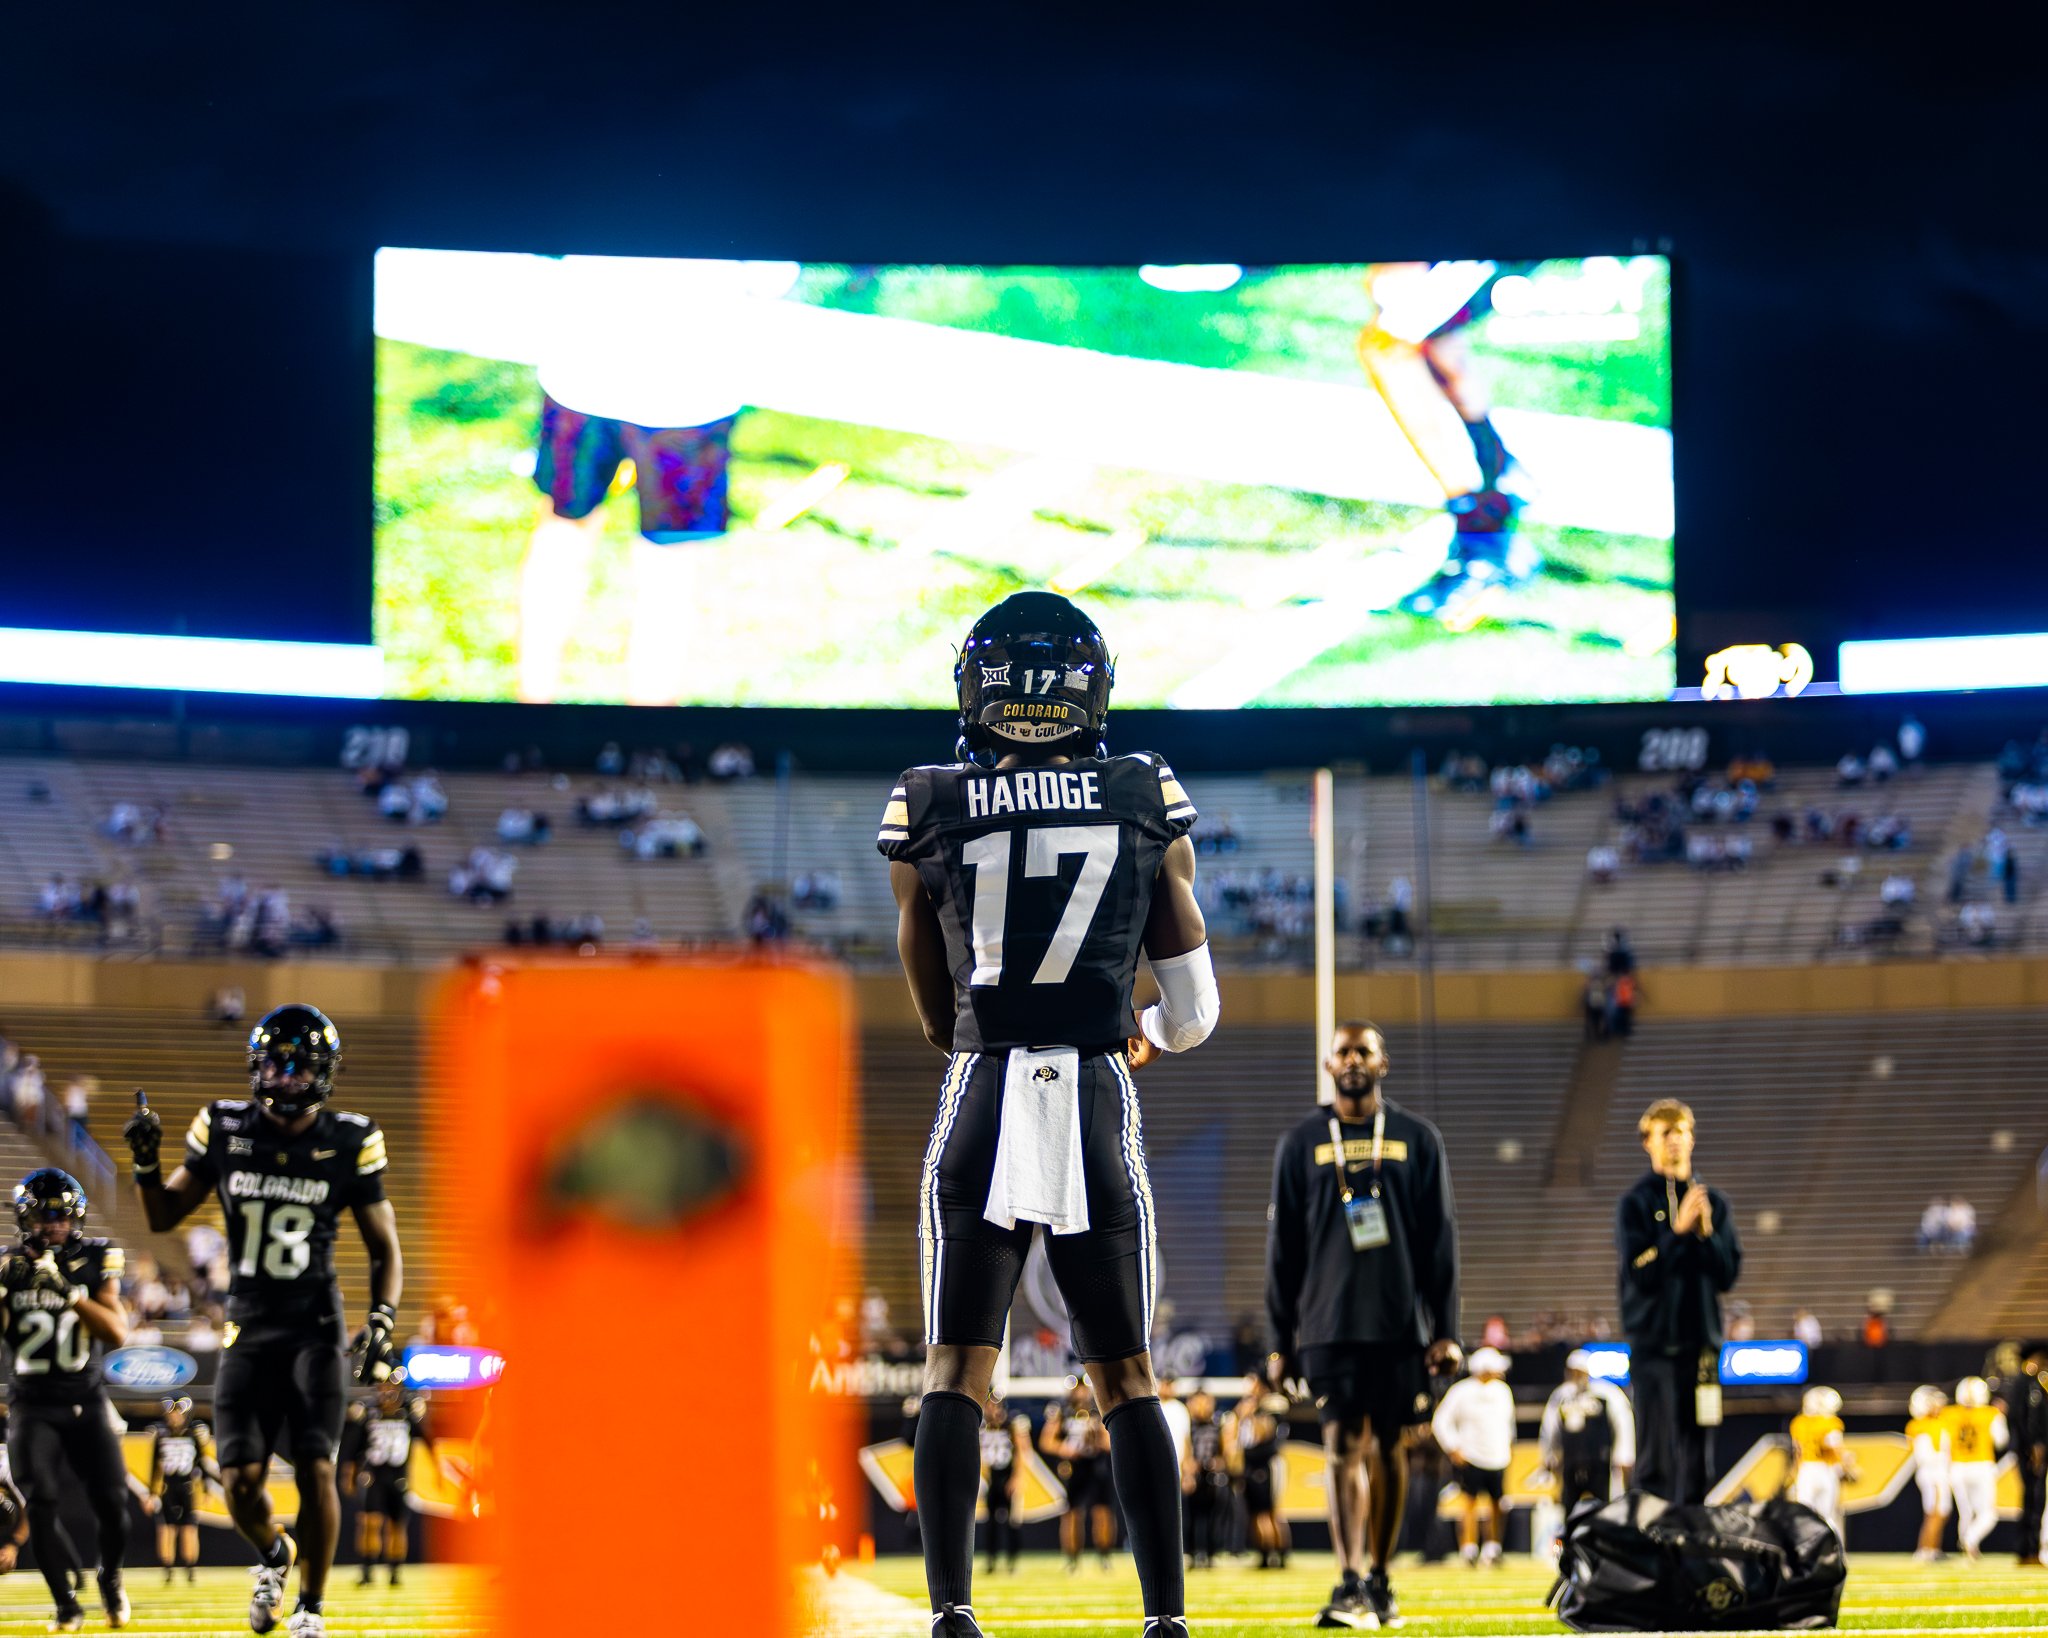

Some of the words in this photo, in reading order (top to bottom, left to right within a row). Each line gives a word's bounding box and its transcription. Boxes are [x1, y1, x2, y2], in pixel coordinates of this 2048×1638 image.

[1024, 669, 1056, 694] 17
[1003, 704, 1069, 719] COLORADO
[967, 771, 1102, 818] HARDGE
[963, 825, 1120, 987] 17
[228, 1171, 330, 1204] COLORADO
[237, 1200, 315, 1280] 18
[15, 1310, 90, 1375] 20
